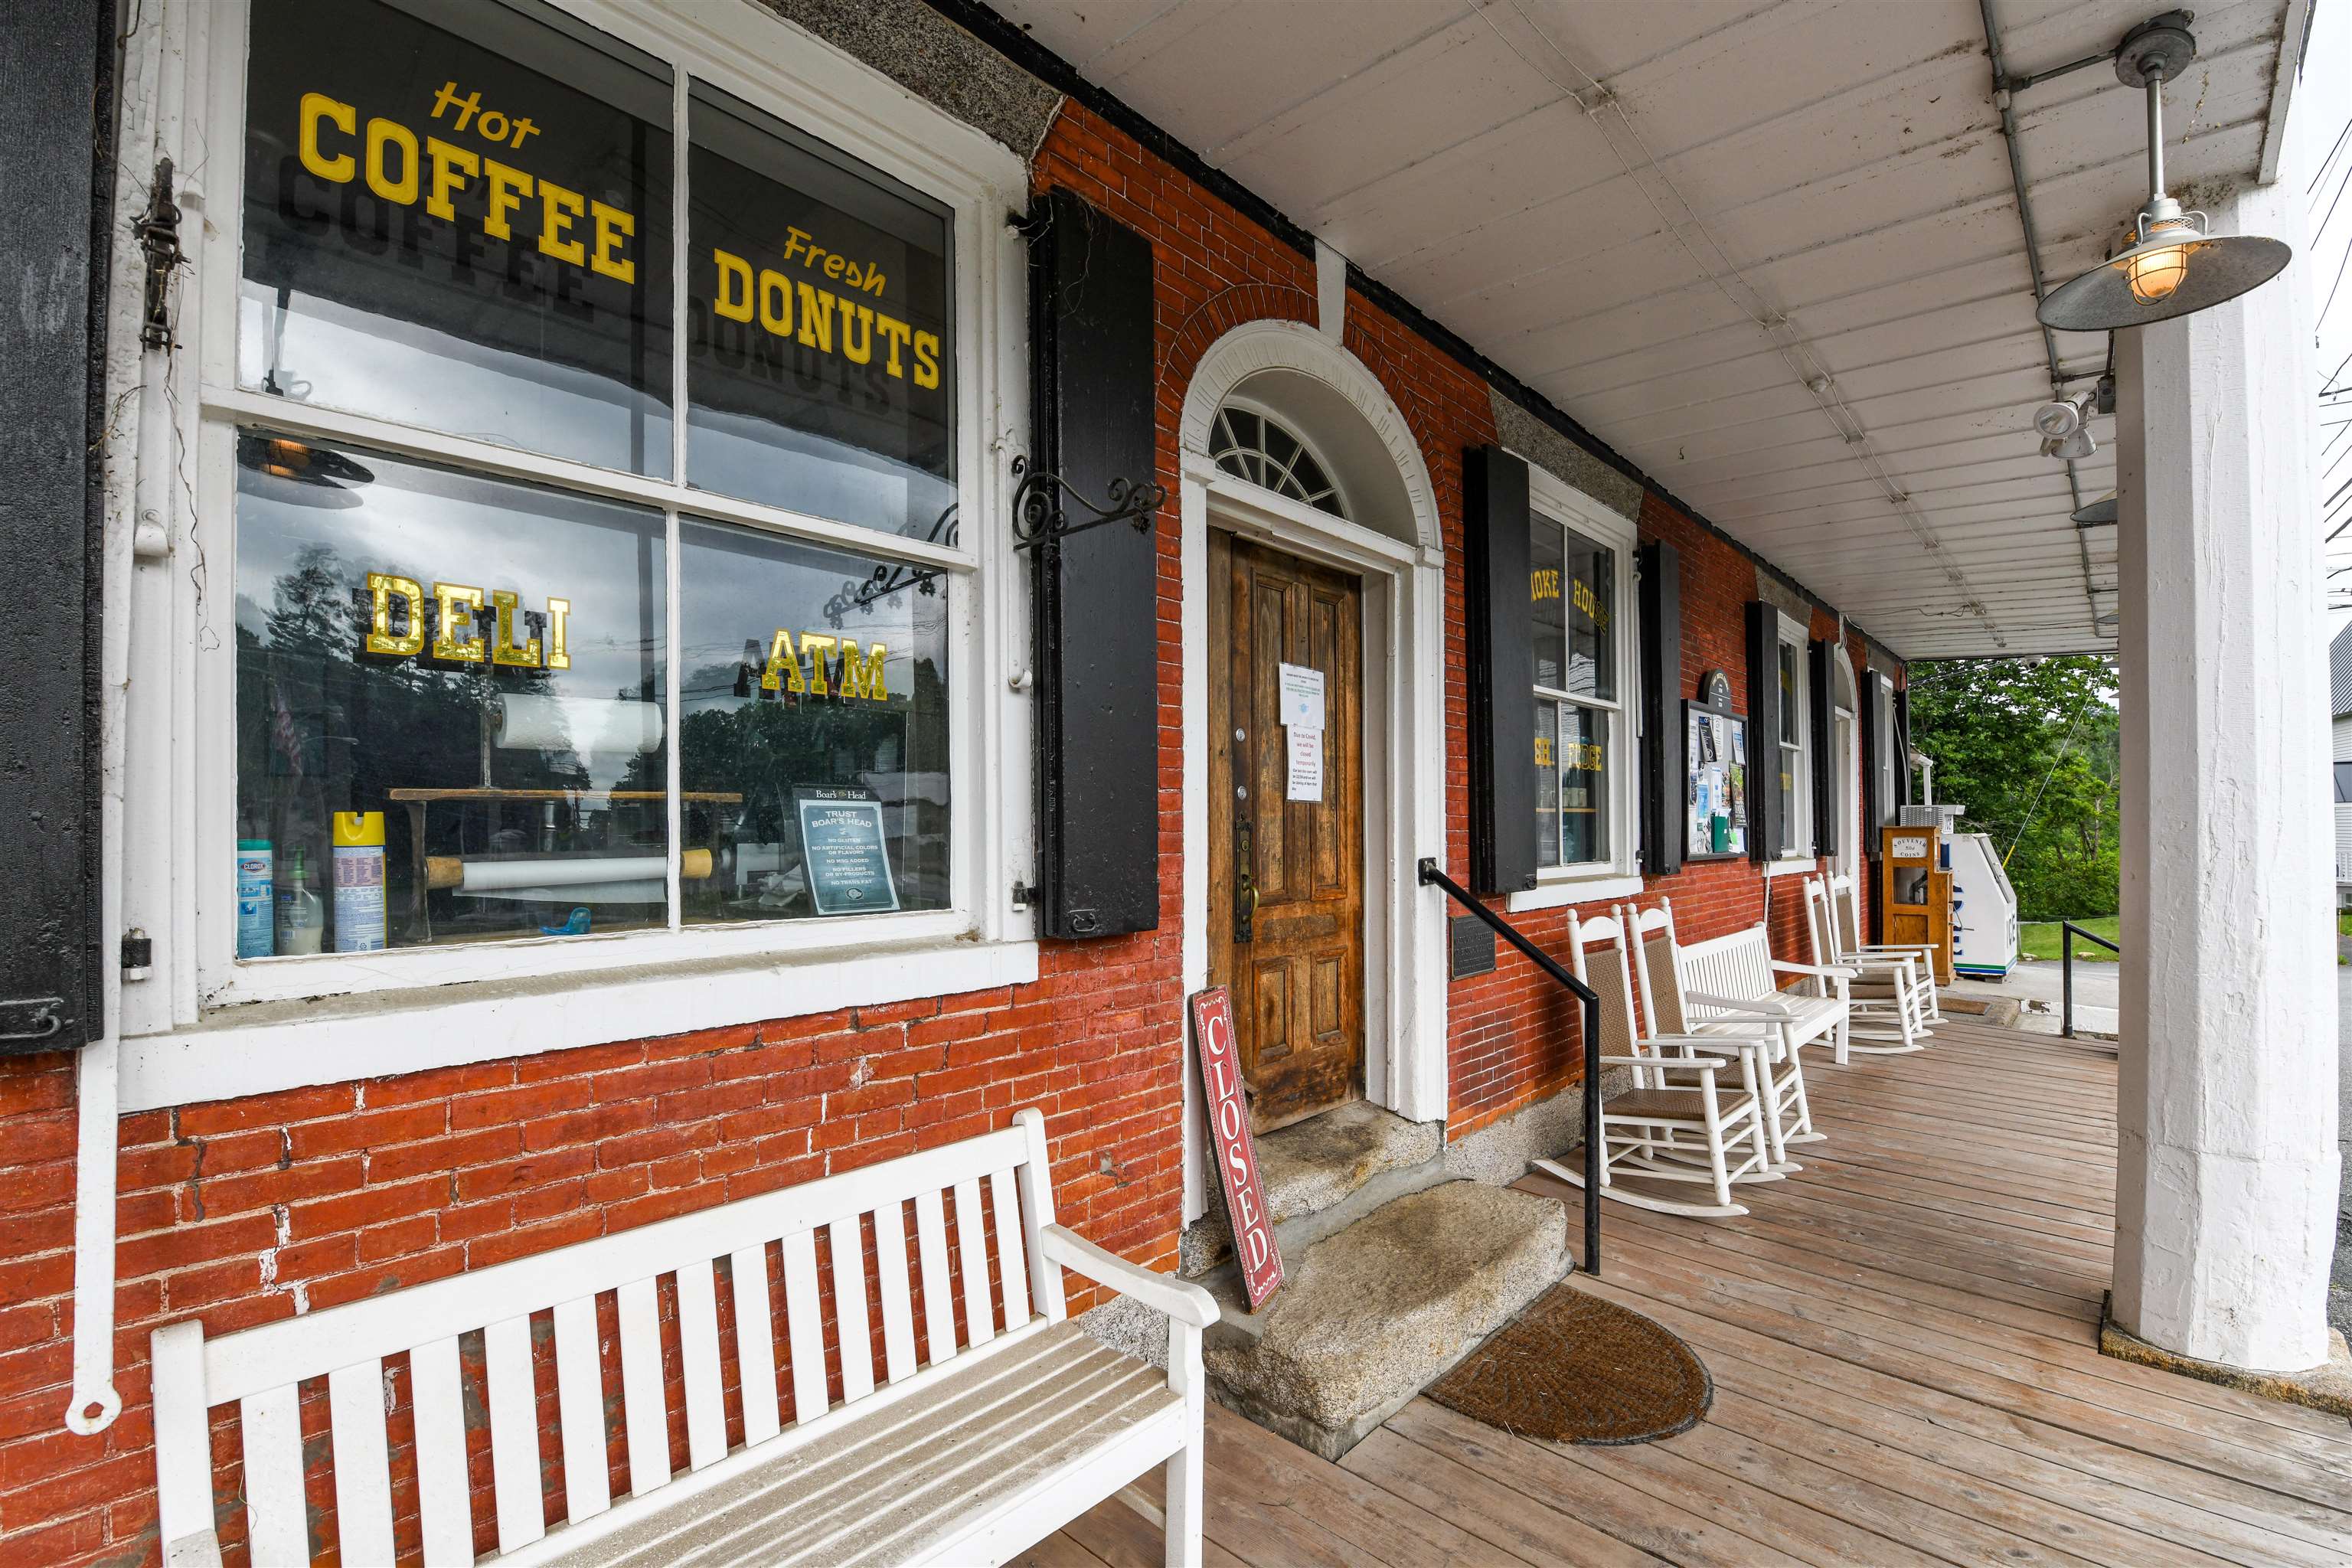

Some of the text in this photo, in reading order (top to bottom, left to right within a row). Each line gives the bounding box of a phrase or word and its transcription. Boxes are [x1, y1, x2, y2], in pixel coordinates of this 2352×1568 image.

[430, 81, 541, 149] Hot
[299, 92, 635, 285] COFFEE
[783, 225, 887, 297] Fresh
[714, 248, 939, 390] DONUTS
[366, 572, 571, 670] DELI
[1530, 569, 1609, 636] OKE HOUSE
[761, 628, 887, 701] ATM
[1568, 742, 1602, 772] FUDGE
[812, 818, 872, 828] BOAR'S HEAD
[816, 790, 866, 799] Boar's Head
[2006, 913, 2015, 951] ICE
[1207, 1015, 1268, 1274] CLOSED
